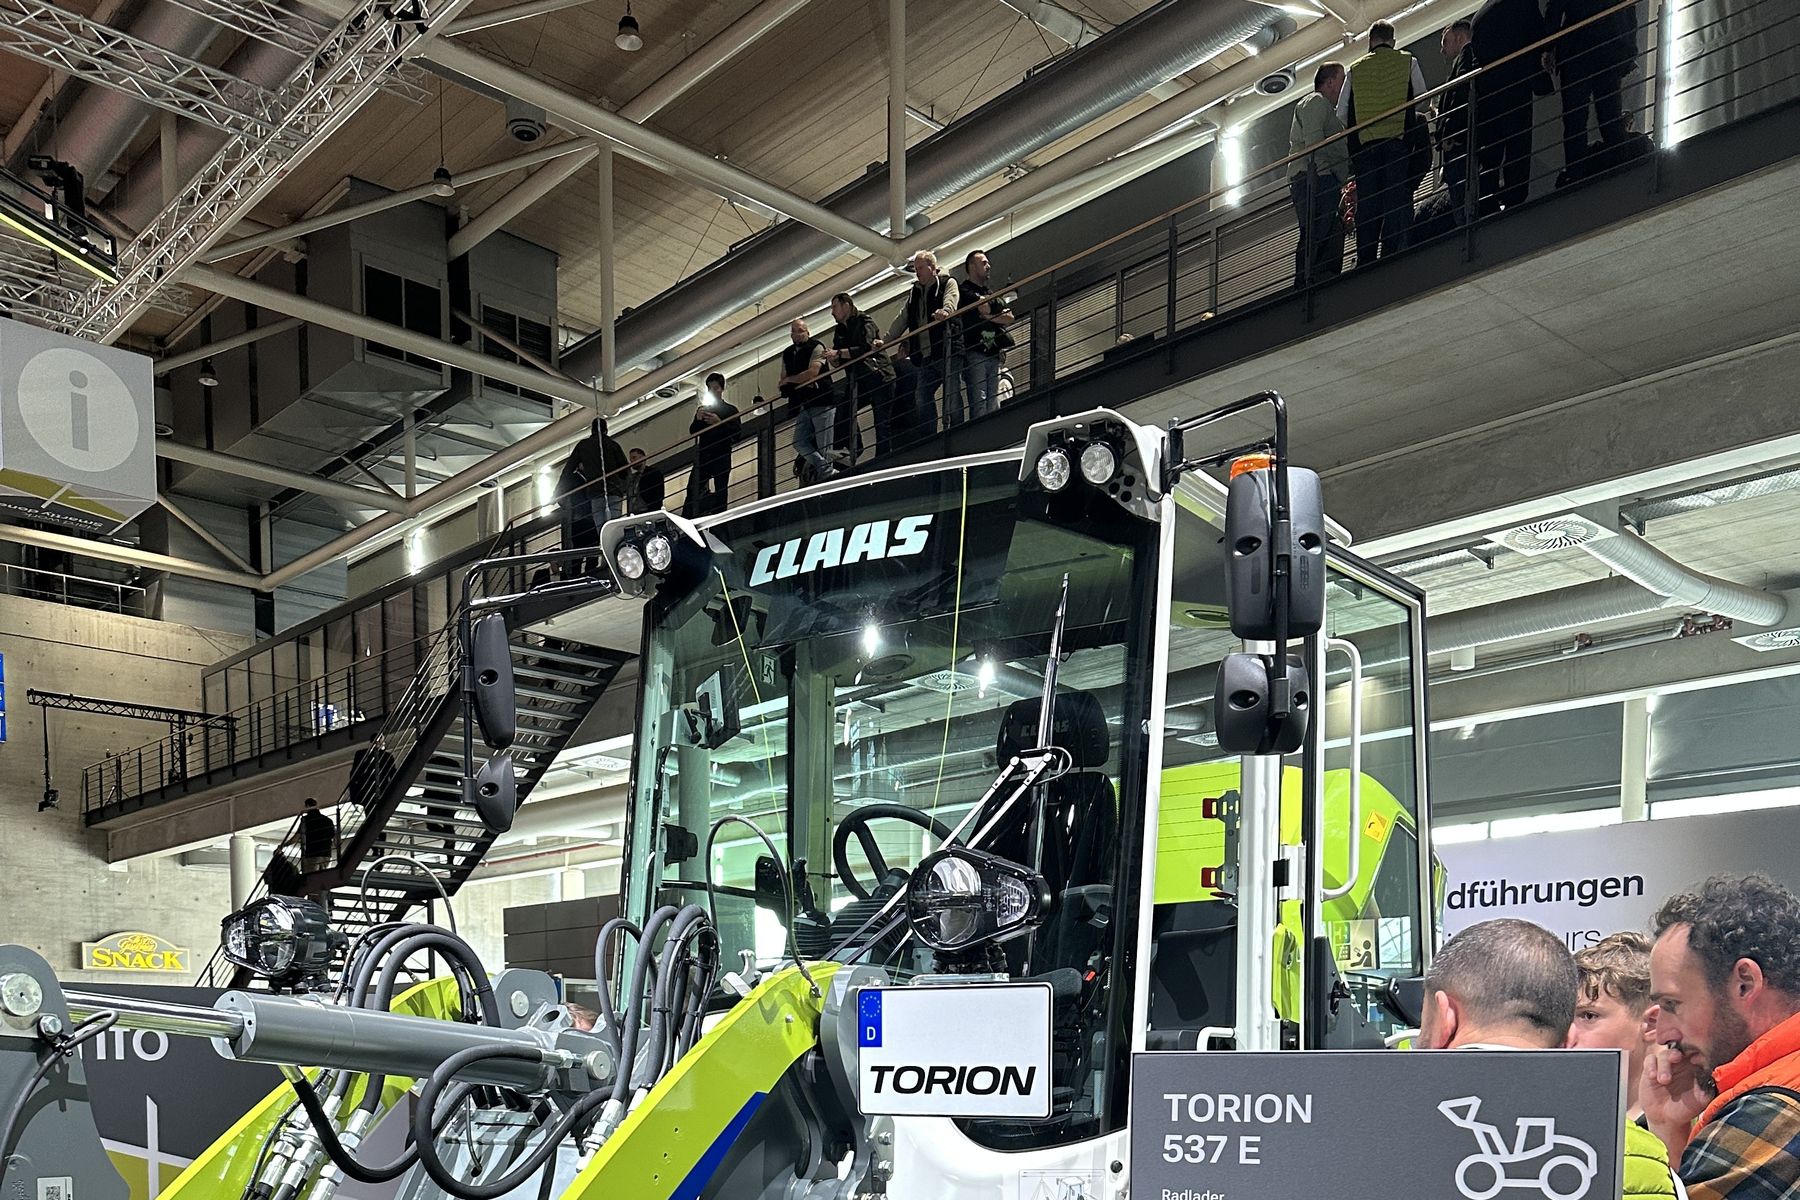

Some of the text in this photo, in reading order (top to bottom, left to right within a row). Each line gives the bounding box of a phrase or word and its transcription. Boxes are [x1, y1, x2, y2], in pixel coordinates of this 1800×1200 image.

[750, 514, 934, 587] CLAAS
[1447, 875, 1644, 910] dführungen
[92, 947, 185, 970] SNACK
[866, 1026, 876, 1041] D
[870, 1065, 1036, 1096] TORION
[1163, 1093, 1312, 1124] TORION
[1162, 1134, 1261, 1165] 537 E
